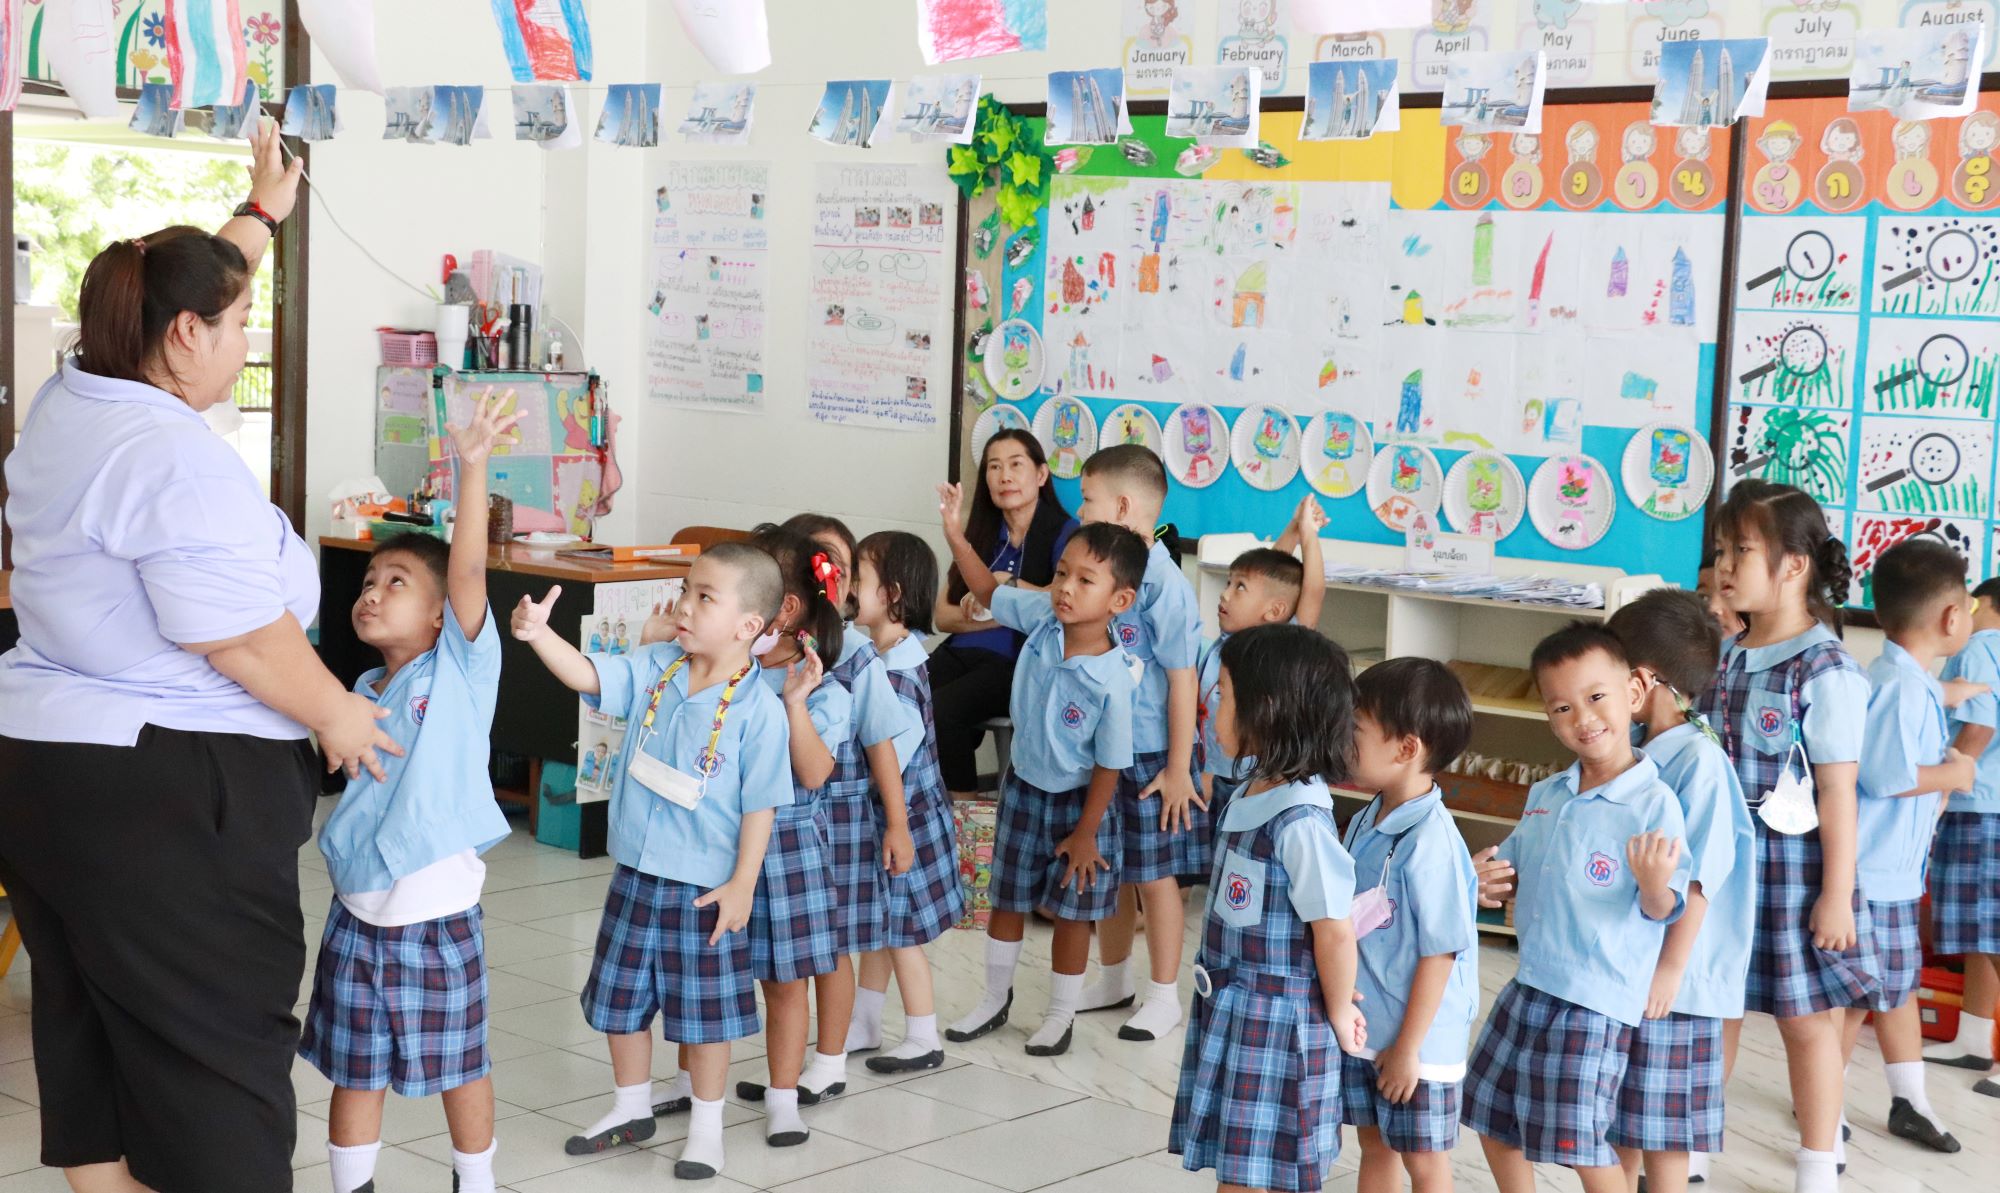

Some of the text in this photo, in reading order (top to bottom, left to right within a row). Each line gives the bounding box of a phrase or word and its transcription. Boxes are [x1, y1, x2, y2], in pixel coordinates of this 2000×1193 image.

[1656, 27, 1700, 42] June
[1795, 16, 1832, 37] July
[1331, 42, 1374, 57] March
[1435, 37, 1470, 55] April
[1543, 32, 1573, 50] May
[1132, 50, 1186, 64] January
[1222, 47, 1284, 63] February
[1774, 45, 1848, 63] กรกฎาคม
